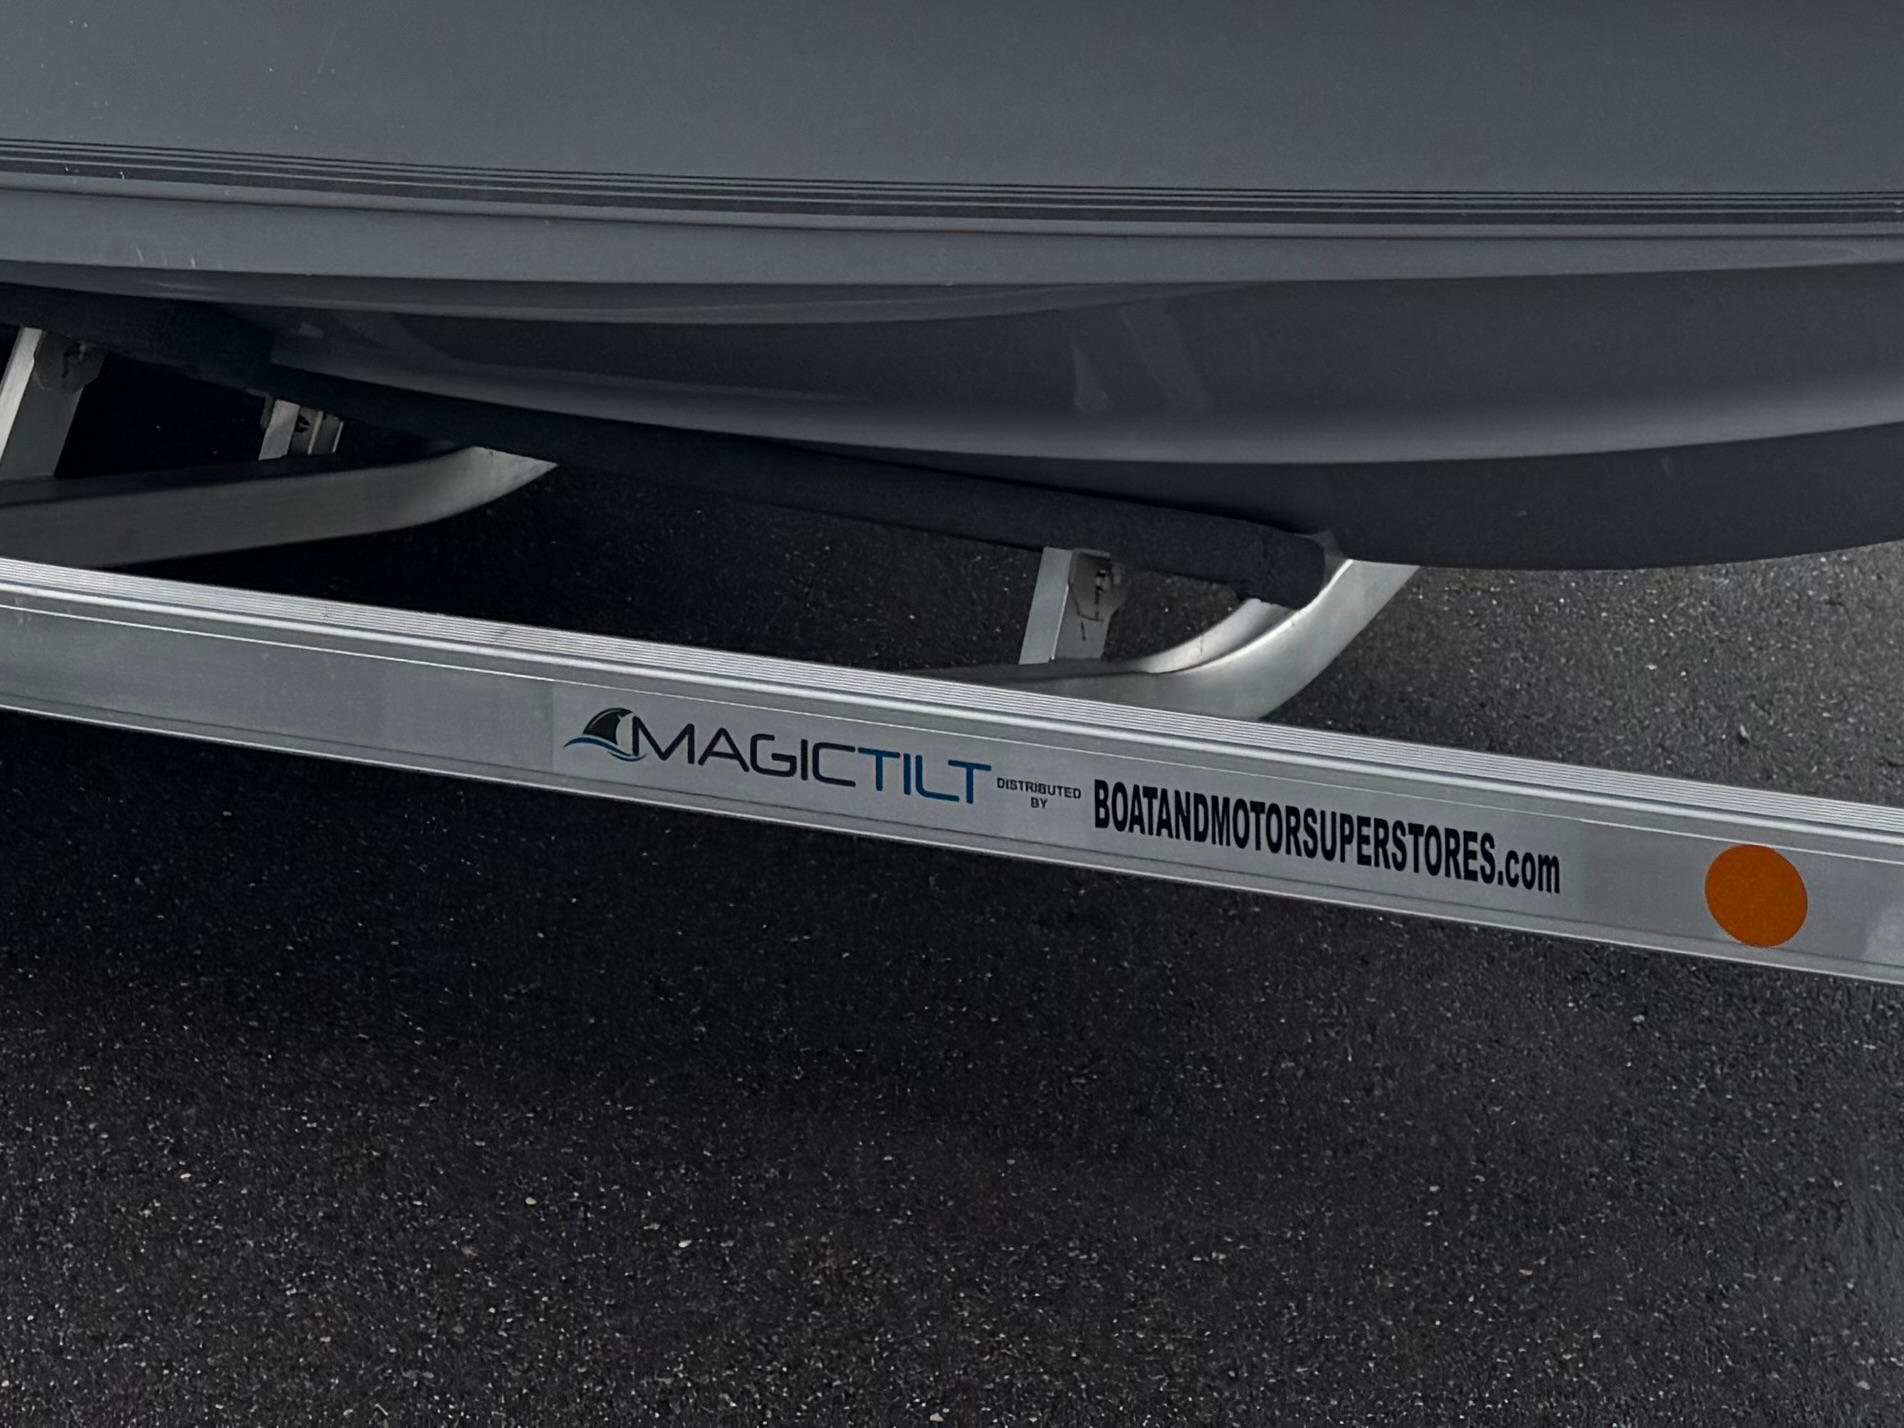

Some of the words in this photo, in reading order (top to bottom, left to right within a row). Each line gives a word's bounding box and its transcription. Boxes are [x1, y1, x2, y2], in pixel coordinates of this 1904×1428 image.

[631, 715, 992, 805] MAGICTILT
[997, 776, 1082, 800] DISTRIBUTED
[1030, 796, 1049, 809] BY
[1093, 778, 1561, 895] BOATANDMOTORSUPERSTORES.com
